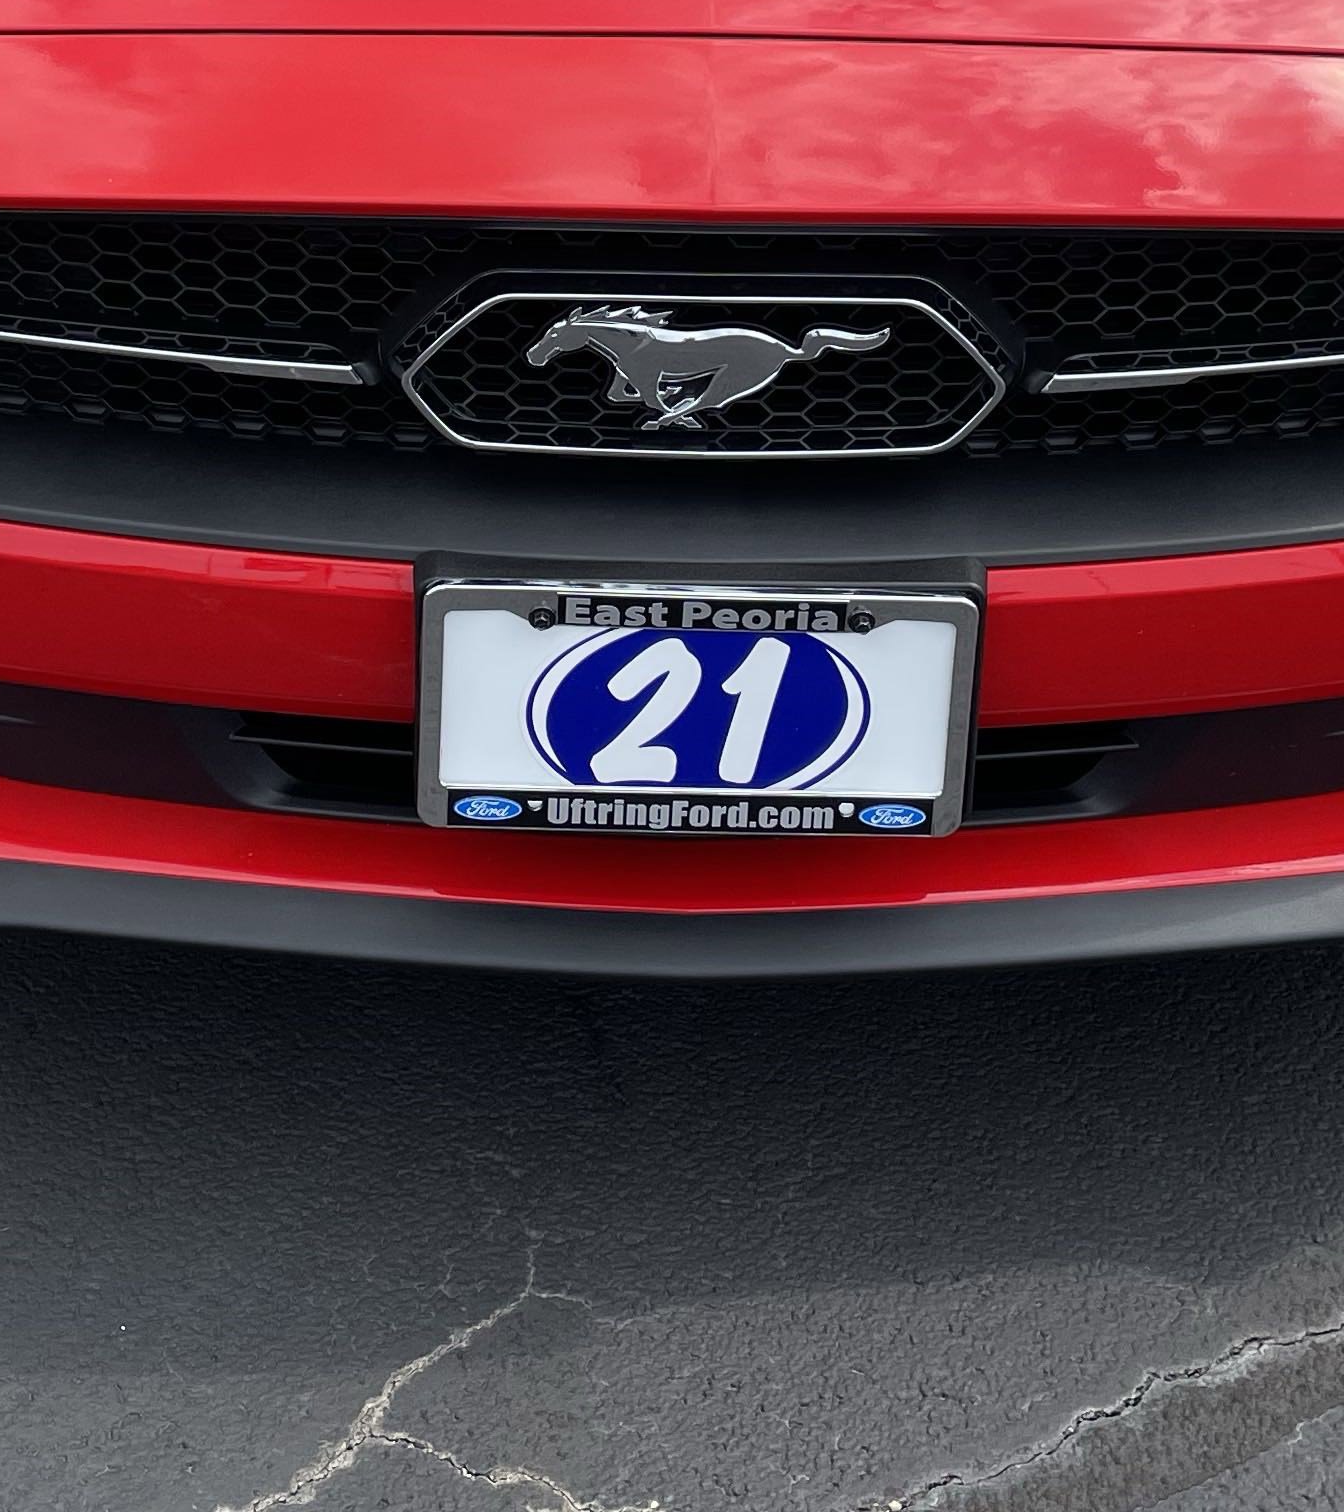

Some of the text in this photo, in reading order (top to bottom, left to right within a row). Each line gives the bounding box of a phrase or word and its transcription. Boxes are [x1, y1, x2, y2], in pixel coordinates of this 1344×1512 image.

[565, 597, 839, 632] East Peoria
[589, 637, 792, 784] 21
[467, 797, 913, 830] Ford UftringFord.com Ford
